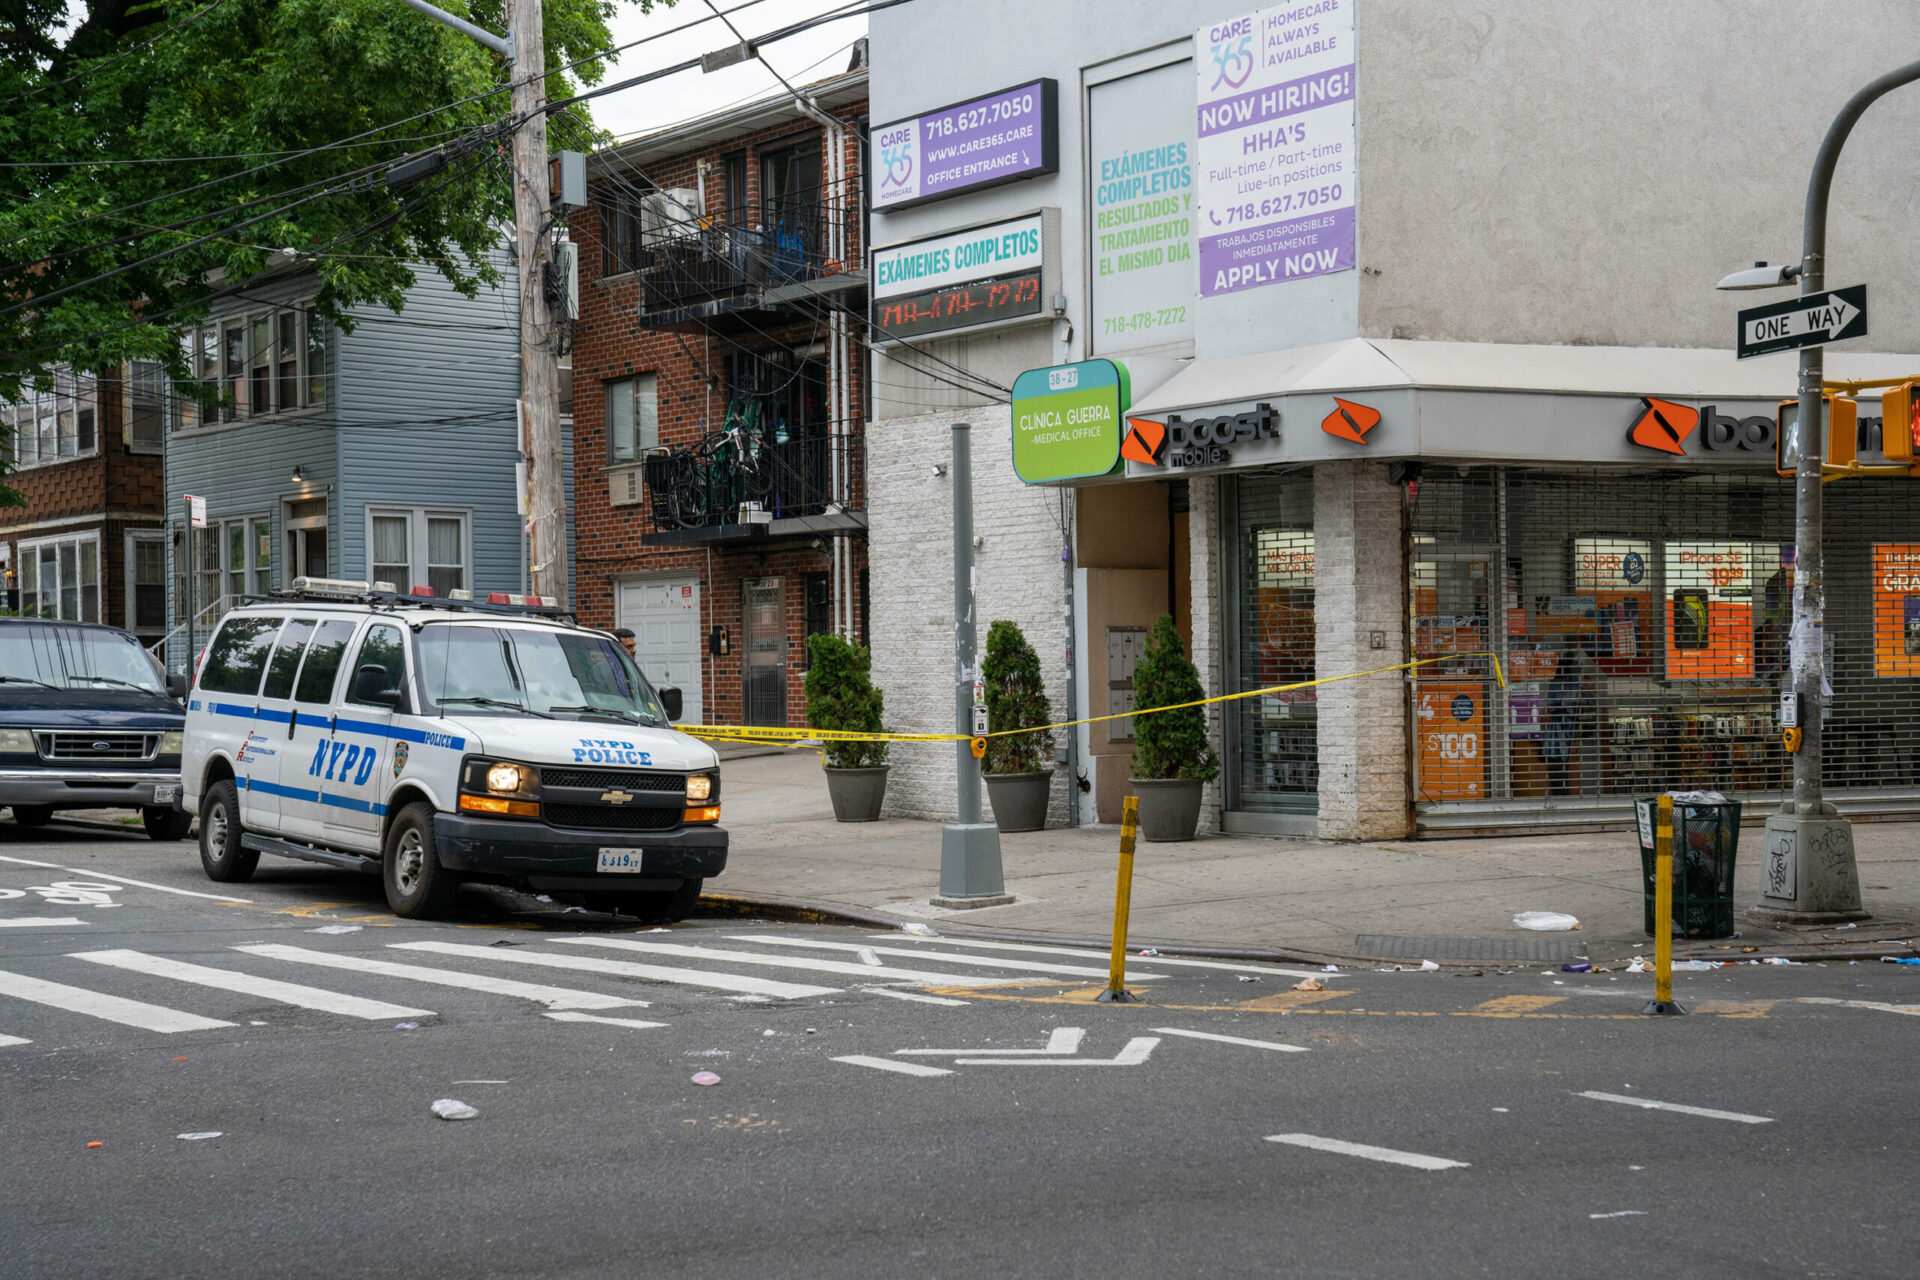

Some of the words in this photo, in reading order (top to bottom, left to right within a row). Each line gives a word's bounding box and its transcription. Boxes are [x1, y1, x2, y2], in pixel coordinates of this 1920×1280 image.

[1210, 17, 1252, 44] CARE
[1268, 0, 1339, 29] HOMECARE
[1268, 23, 1320, 48] ALWAYS
[1268, 37, 1337, 67] AVAILABLE
[926, 94, 1033, 140] 718.627.7050
[1201, 97, 1255, 132] NOW
[1261, 71, 1350, 116] HIRING!
[880, 127, 911, 149] CARE
[1243, 122, 1306, 155] HHA'S
[927, 166, 961, 185] OFFICE
[963, 152, 1018, 177] ENTRANCE
[1101, 142, 1187, 182] EXÁMENES
[1209, 158, 1267, 184] Full-time
[1277, 141, 1343, 167] Part-time
[1237, 173, 1281, 195] Live-in
[1284, 160, 1343, 189] positions
[881, 186, 913, 200] HOMECARE
[1097, 166, 1191, 207] COMPLETOS
[1097, 199, 1174, 230] RESULTADOS
[1177, 193, 1192, 214] Y
[1226, 183, 1342, 225] 718.627.7050
[1100, 218, 1190, 254] TRATAMIENTO
[1217, 230, 1265, 249] TRABAJOS
[1232, 234, 1319, 260] INMEDIATAMENTE
[878, 252, 951, 285] EXÁMENES
[954, 228, 1039, 270] COMPLETOS
[1099, 257, 1114, 277] EL
[1117, 249, 1163, 272] MISMO
[1167, 241, 1191, 265] DÍA
[1213, 259, 1279, 291] APPLY
[1284, 247, 1339, 277] NOW
[1103, 306, 1186, 337] 718-478-7272
[1755, 316, 1791, 341] ONE
[1808, 304, 1847, 330] WAY
[1066, 404, 1111, 425] GUERRA
[1168, 402, 1279, 449] boost
[1033, 431, 1071, 445] MEDICAL
[1072, 426, 1102, 440] OFFICE
[1171, 449, 1223, 468] mobile
[1583, 554, 1620, 570] SUPER
[425, 731, 452, 749] POLICE
[579, 738, 635, 750] NYPD
[1428, 733, 1477, 759] $100
[309, 738, 377, 786] NYPD
[571, 748, 653, 766] POLICE
